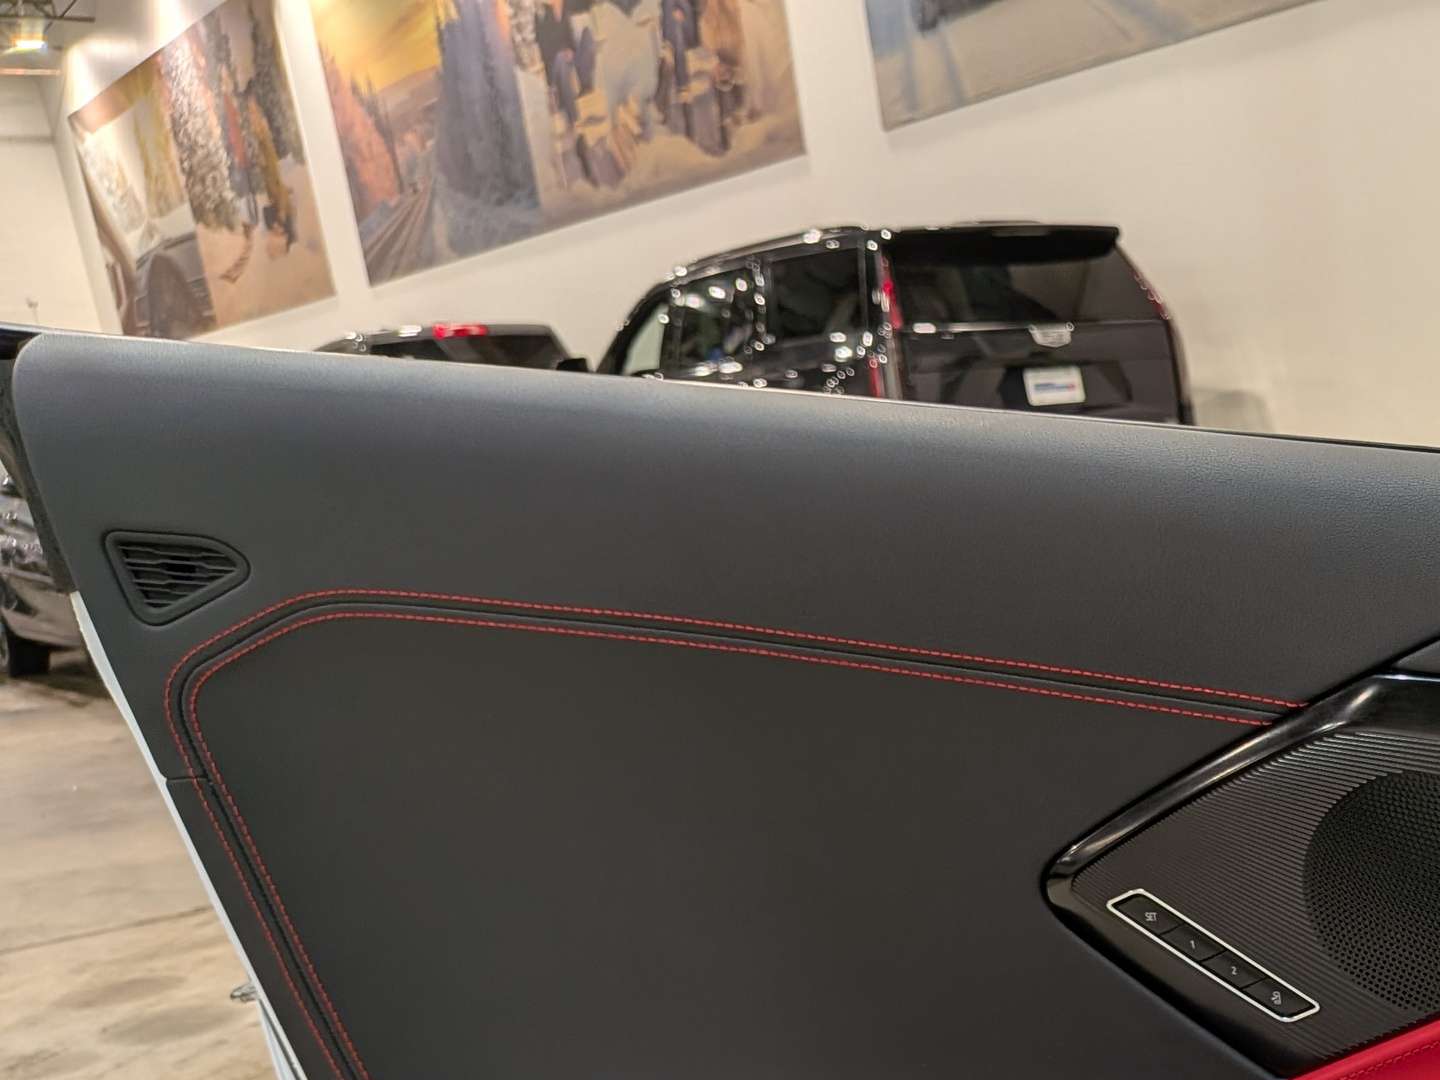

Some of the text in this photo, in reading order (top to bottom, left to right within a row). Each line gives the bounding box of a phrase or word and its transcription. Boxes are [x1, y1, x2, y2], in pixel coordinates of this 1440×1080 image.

[1145, 912, 1157, 921] SET
[1190, 940, 1196, 950] 1
[1231, 966, 1238, 976] 2
